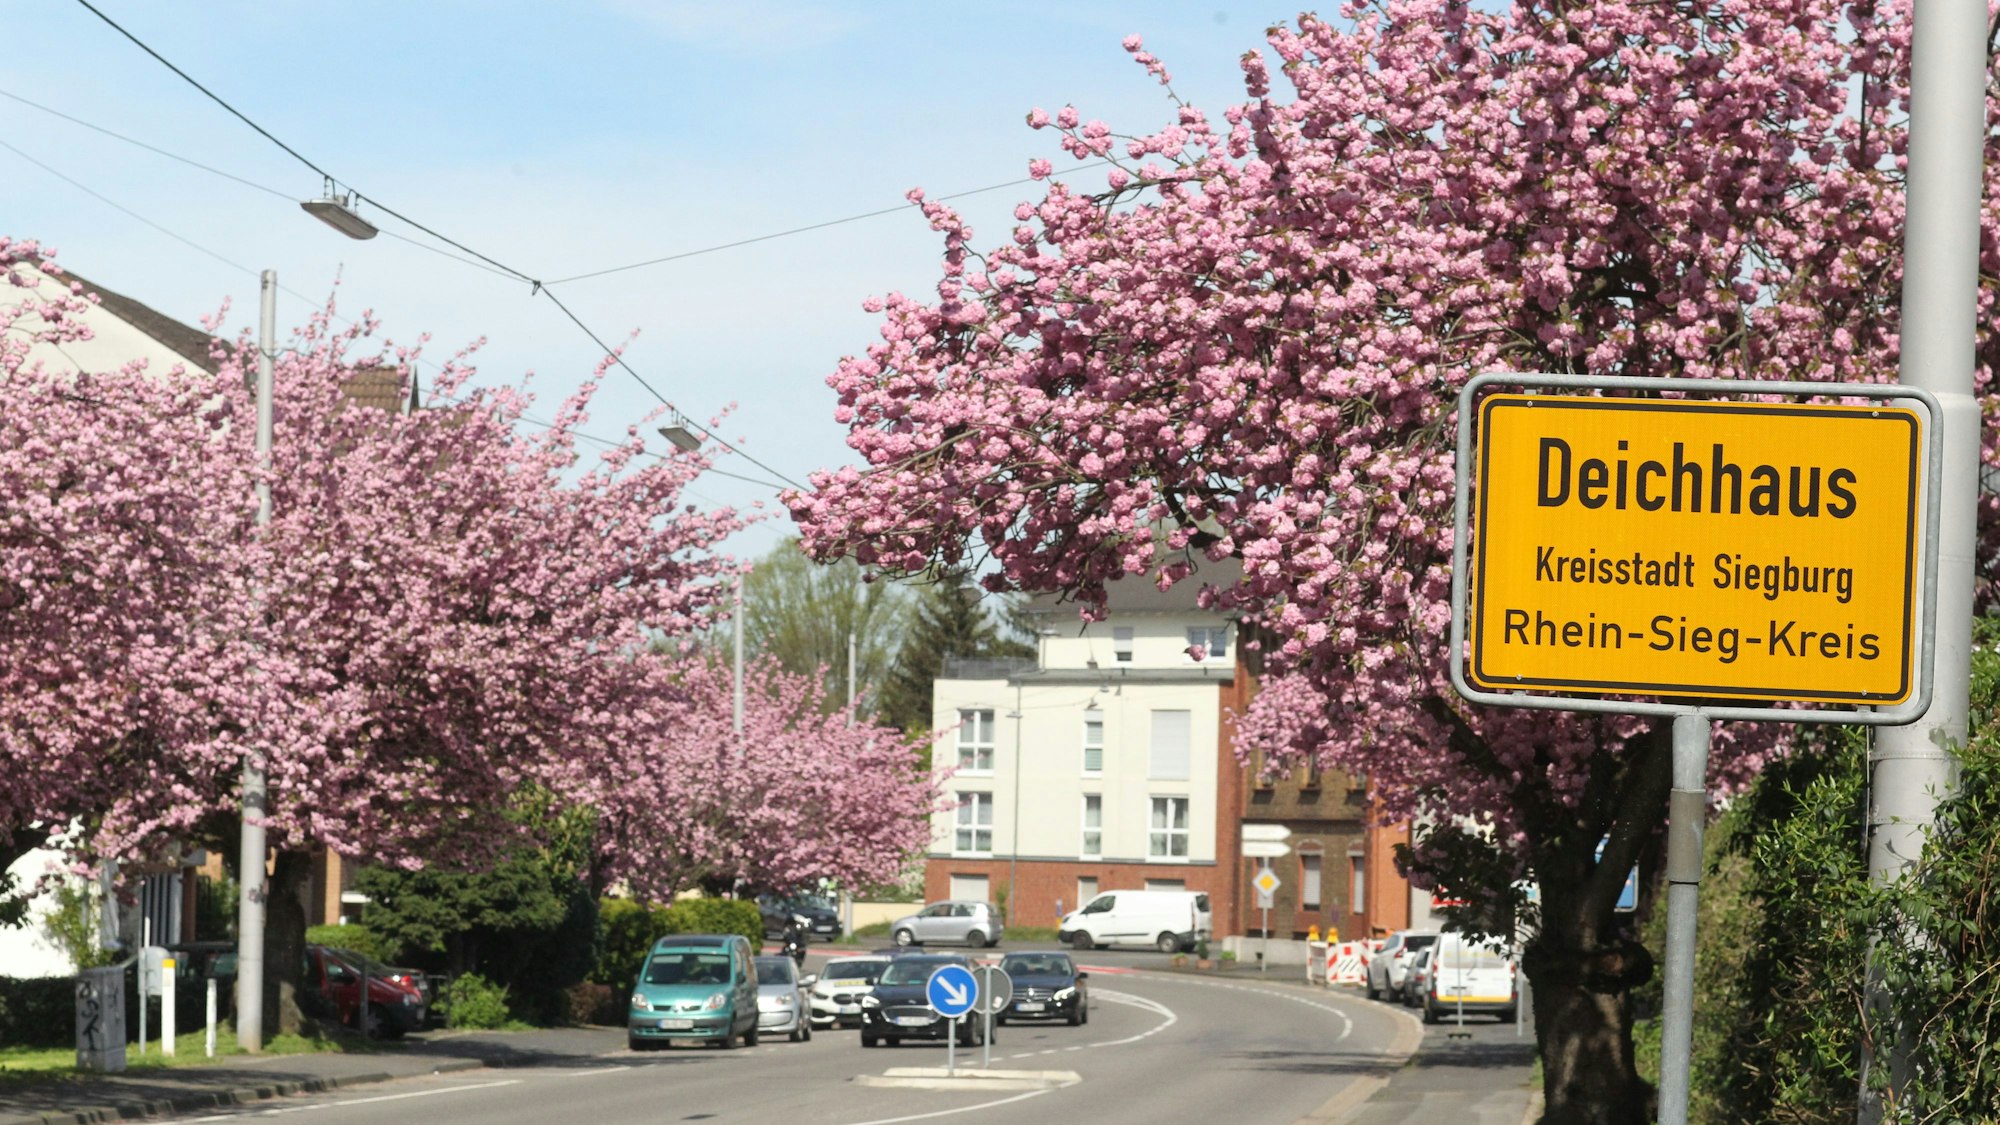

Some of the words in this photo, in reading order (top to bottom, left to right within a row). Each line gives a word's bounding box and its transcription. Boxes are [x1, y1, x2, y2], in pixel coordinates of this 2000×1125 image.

[1537, 437, 1857, 519] Deichhaus
[1536, 546, 1694, 588] Kreisstadt
[1713, 553, 1853, 604] Siegburg
[1504, 608, 1880, 664] Rhein-Sieg-Kreis
